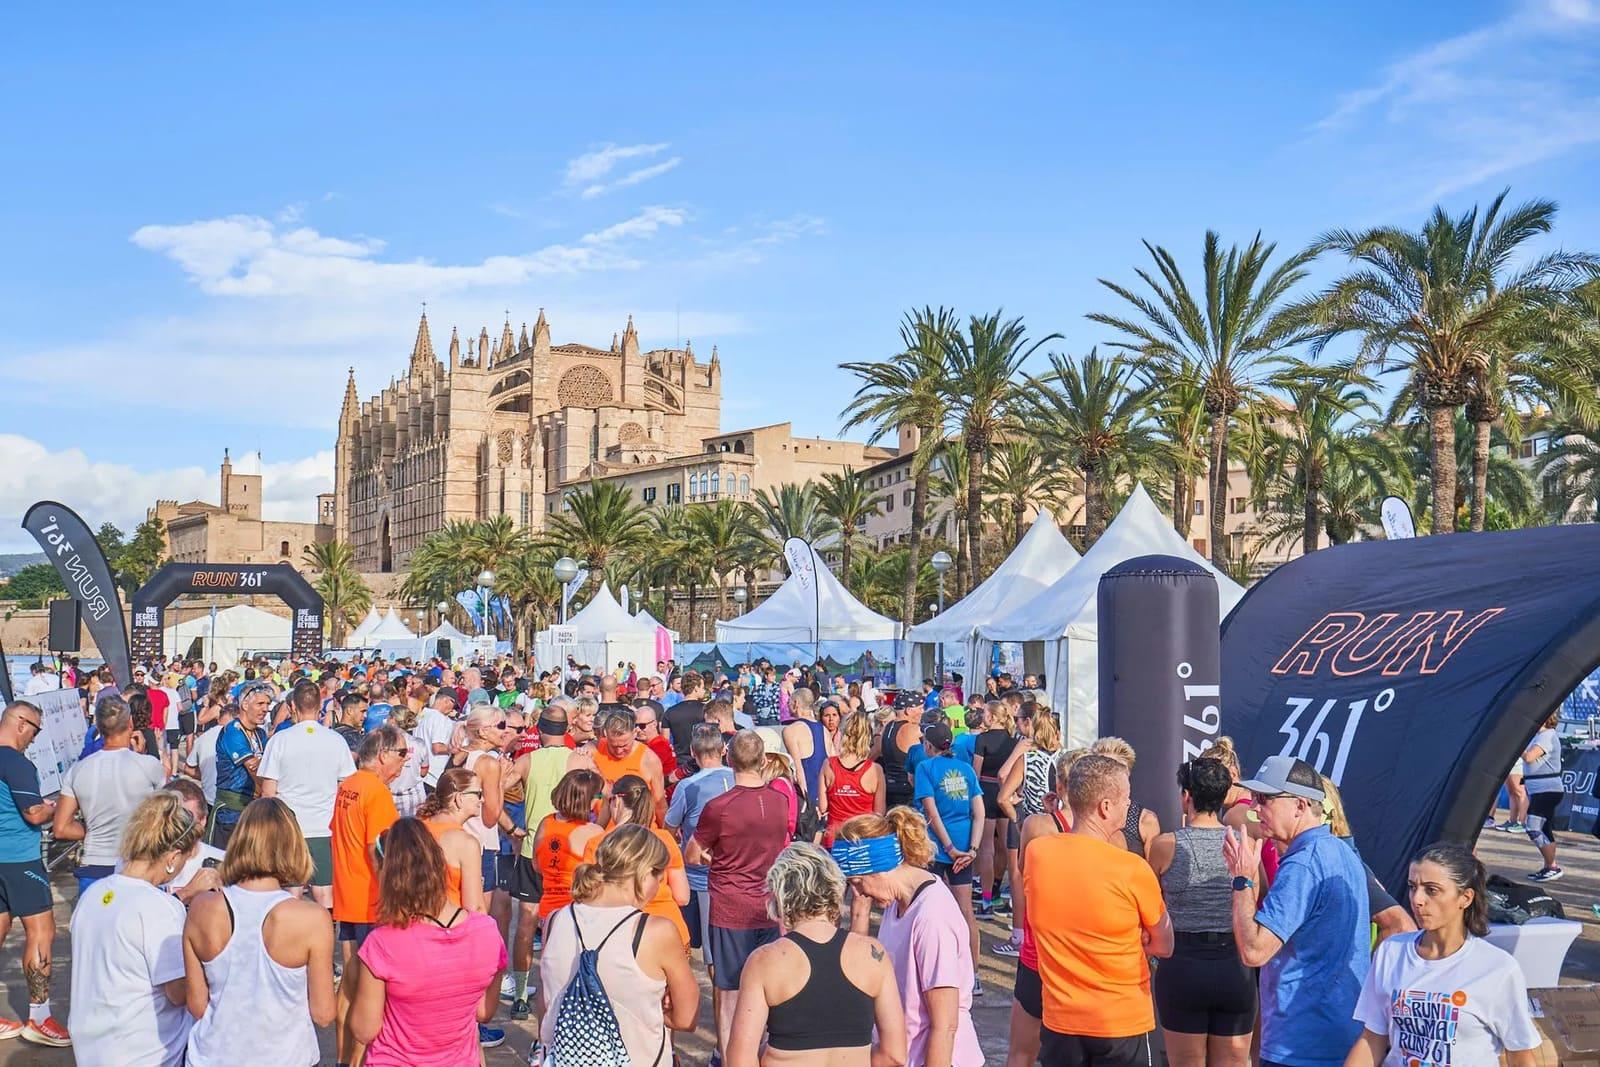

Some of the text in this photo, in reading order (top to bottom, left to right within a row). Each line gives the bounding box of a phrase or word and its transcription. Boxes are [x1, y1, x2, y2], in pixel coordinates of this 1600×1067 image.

[192, 571, 238, 587] RUN
[135, 620, 159, 628] BEYOND
[1270, 606, 1508, 677] RUN
[1561, 770, 1598, 796] RU
[1411, 1001, 1441, 1019] RUN
